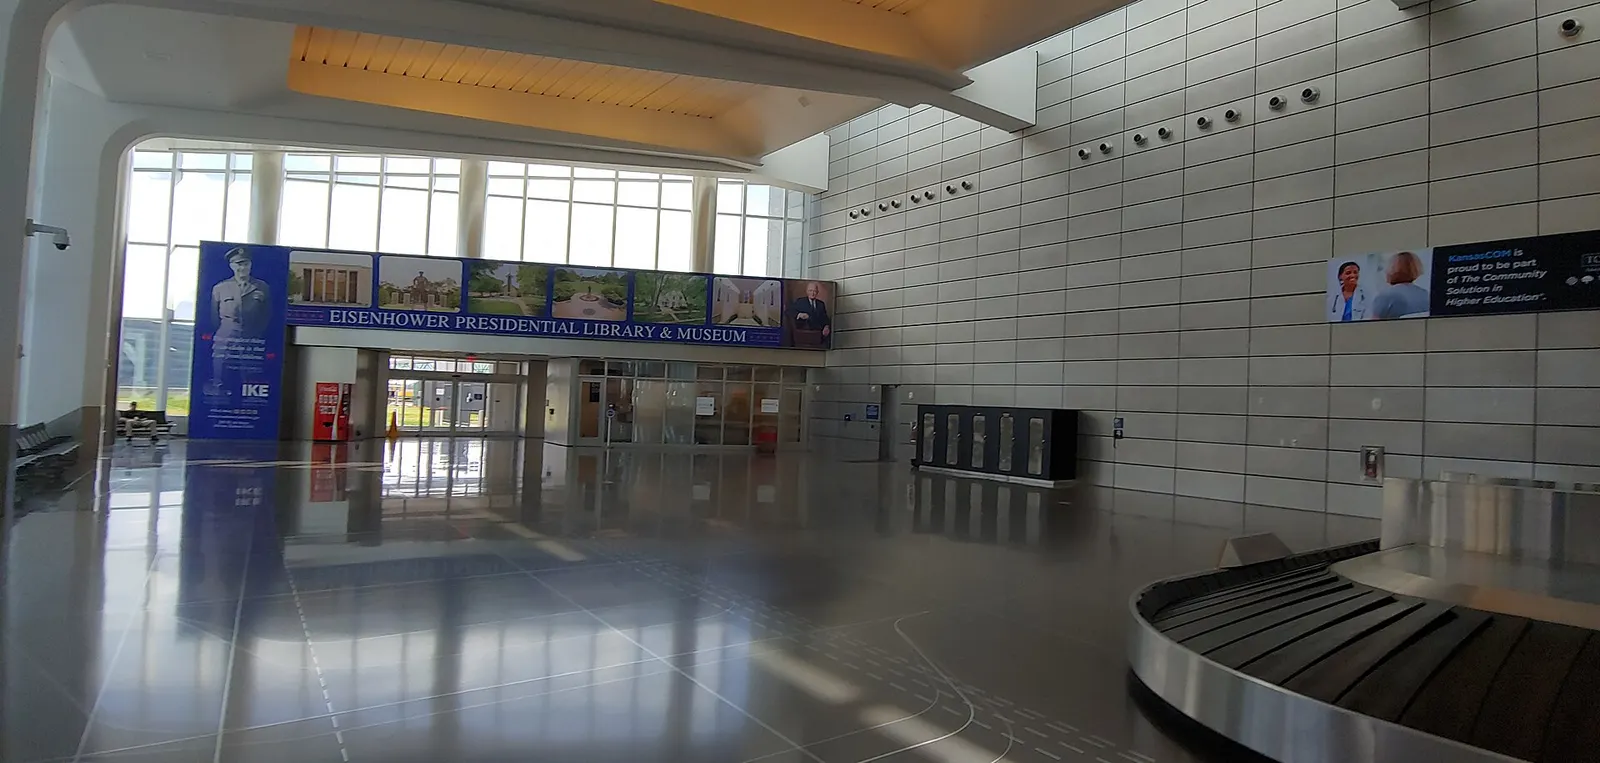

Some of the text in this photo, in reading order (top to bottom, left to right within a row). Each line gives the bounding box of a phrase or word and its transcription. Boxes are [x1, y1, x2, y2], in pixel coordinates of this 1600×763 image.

[1448, 248, 1524, 262] KansasCOM is
[1447, 259, 1538, 275] proud to be part
[1446, 270, 1548, 284] of The Community
[1446, 284, 1503, 295] Solution in
[1445, 297, 1482, 307] Higher
[329, 309, 747, 343] EISENHOWER PRESIDENTIAL LIBRARY & MUSEUM
[242, 384, 269, 397] IKE
